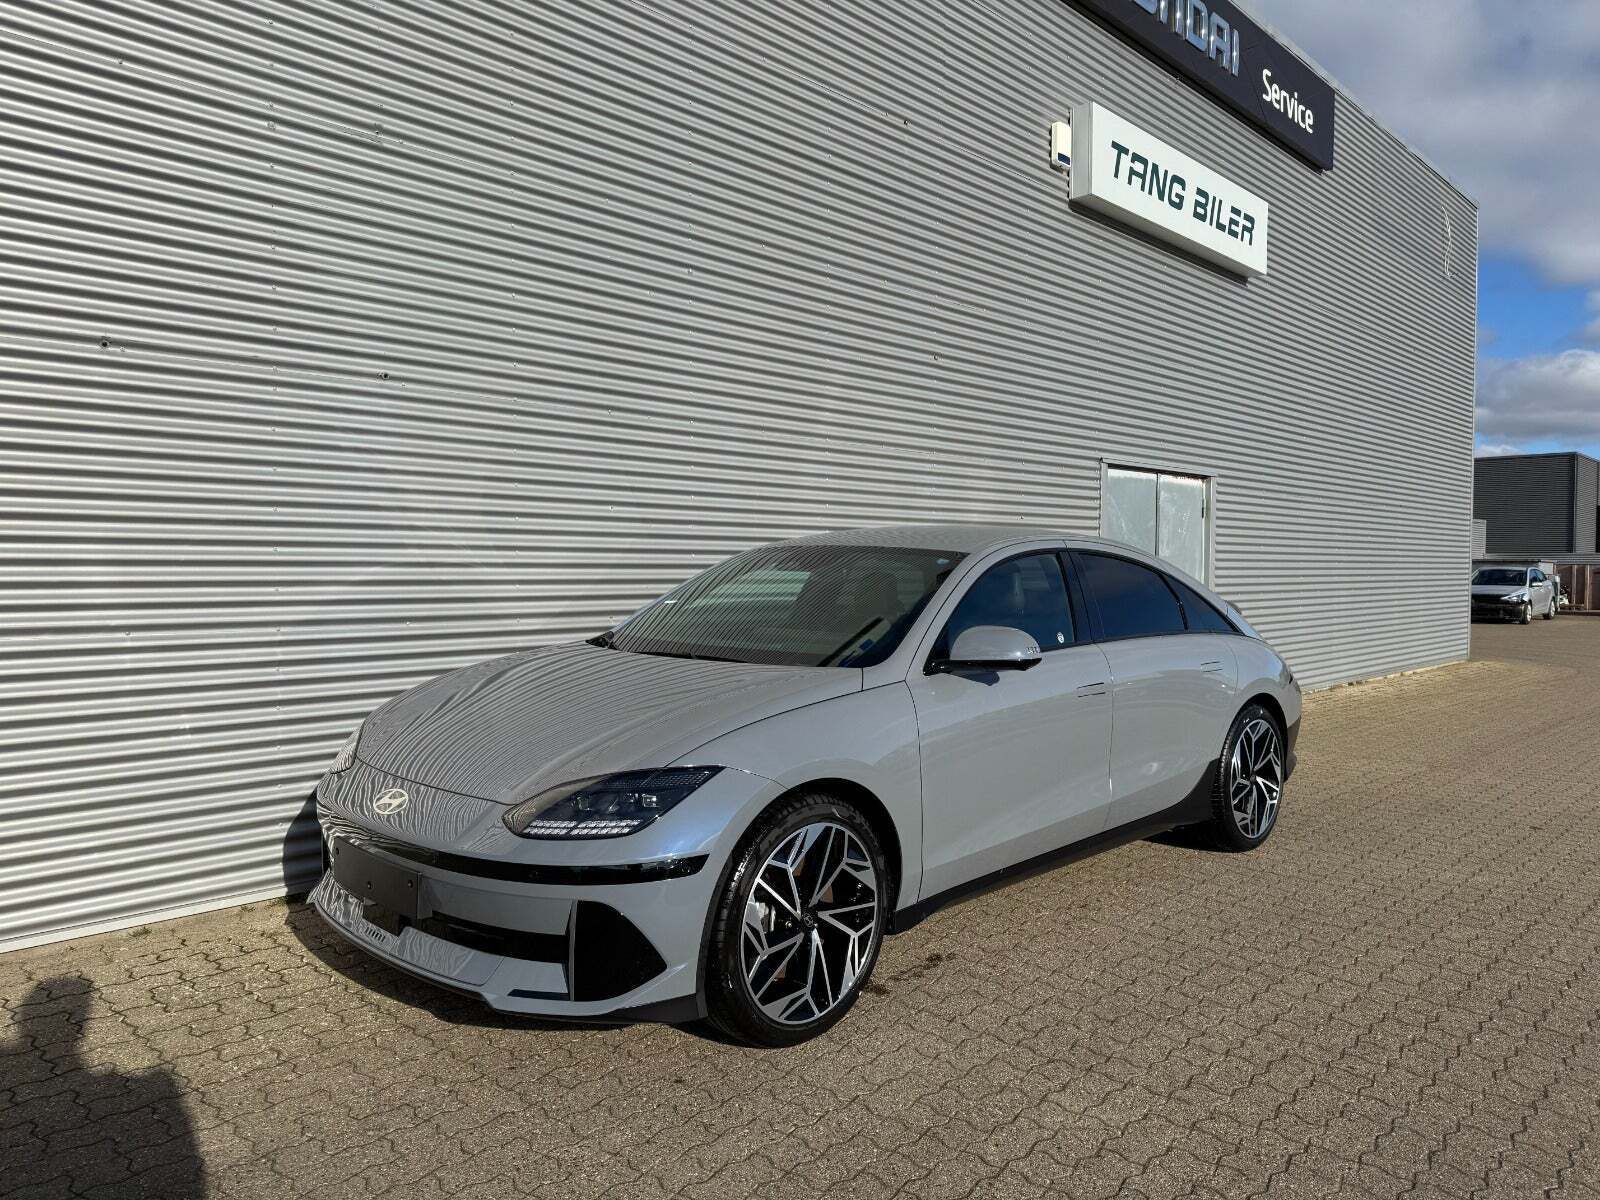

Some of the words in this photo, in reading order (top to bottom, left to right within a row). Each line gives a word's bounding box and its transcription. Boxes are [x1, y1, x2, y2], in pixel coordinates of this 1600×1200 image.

[1262, 68, 1314, 133] Service
[1111, 140, 1186, 211] TANG
[1192, 186, 1256, 246] BILER
